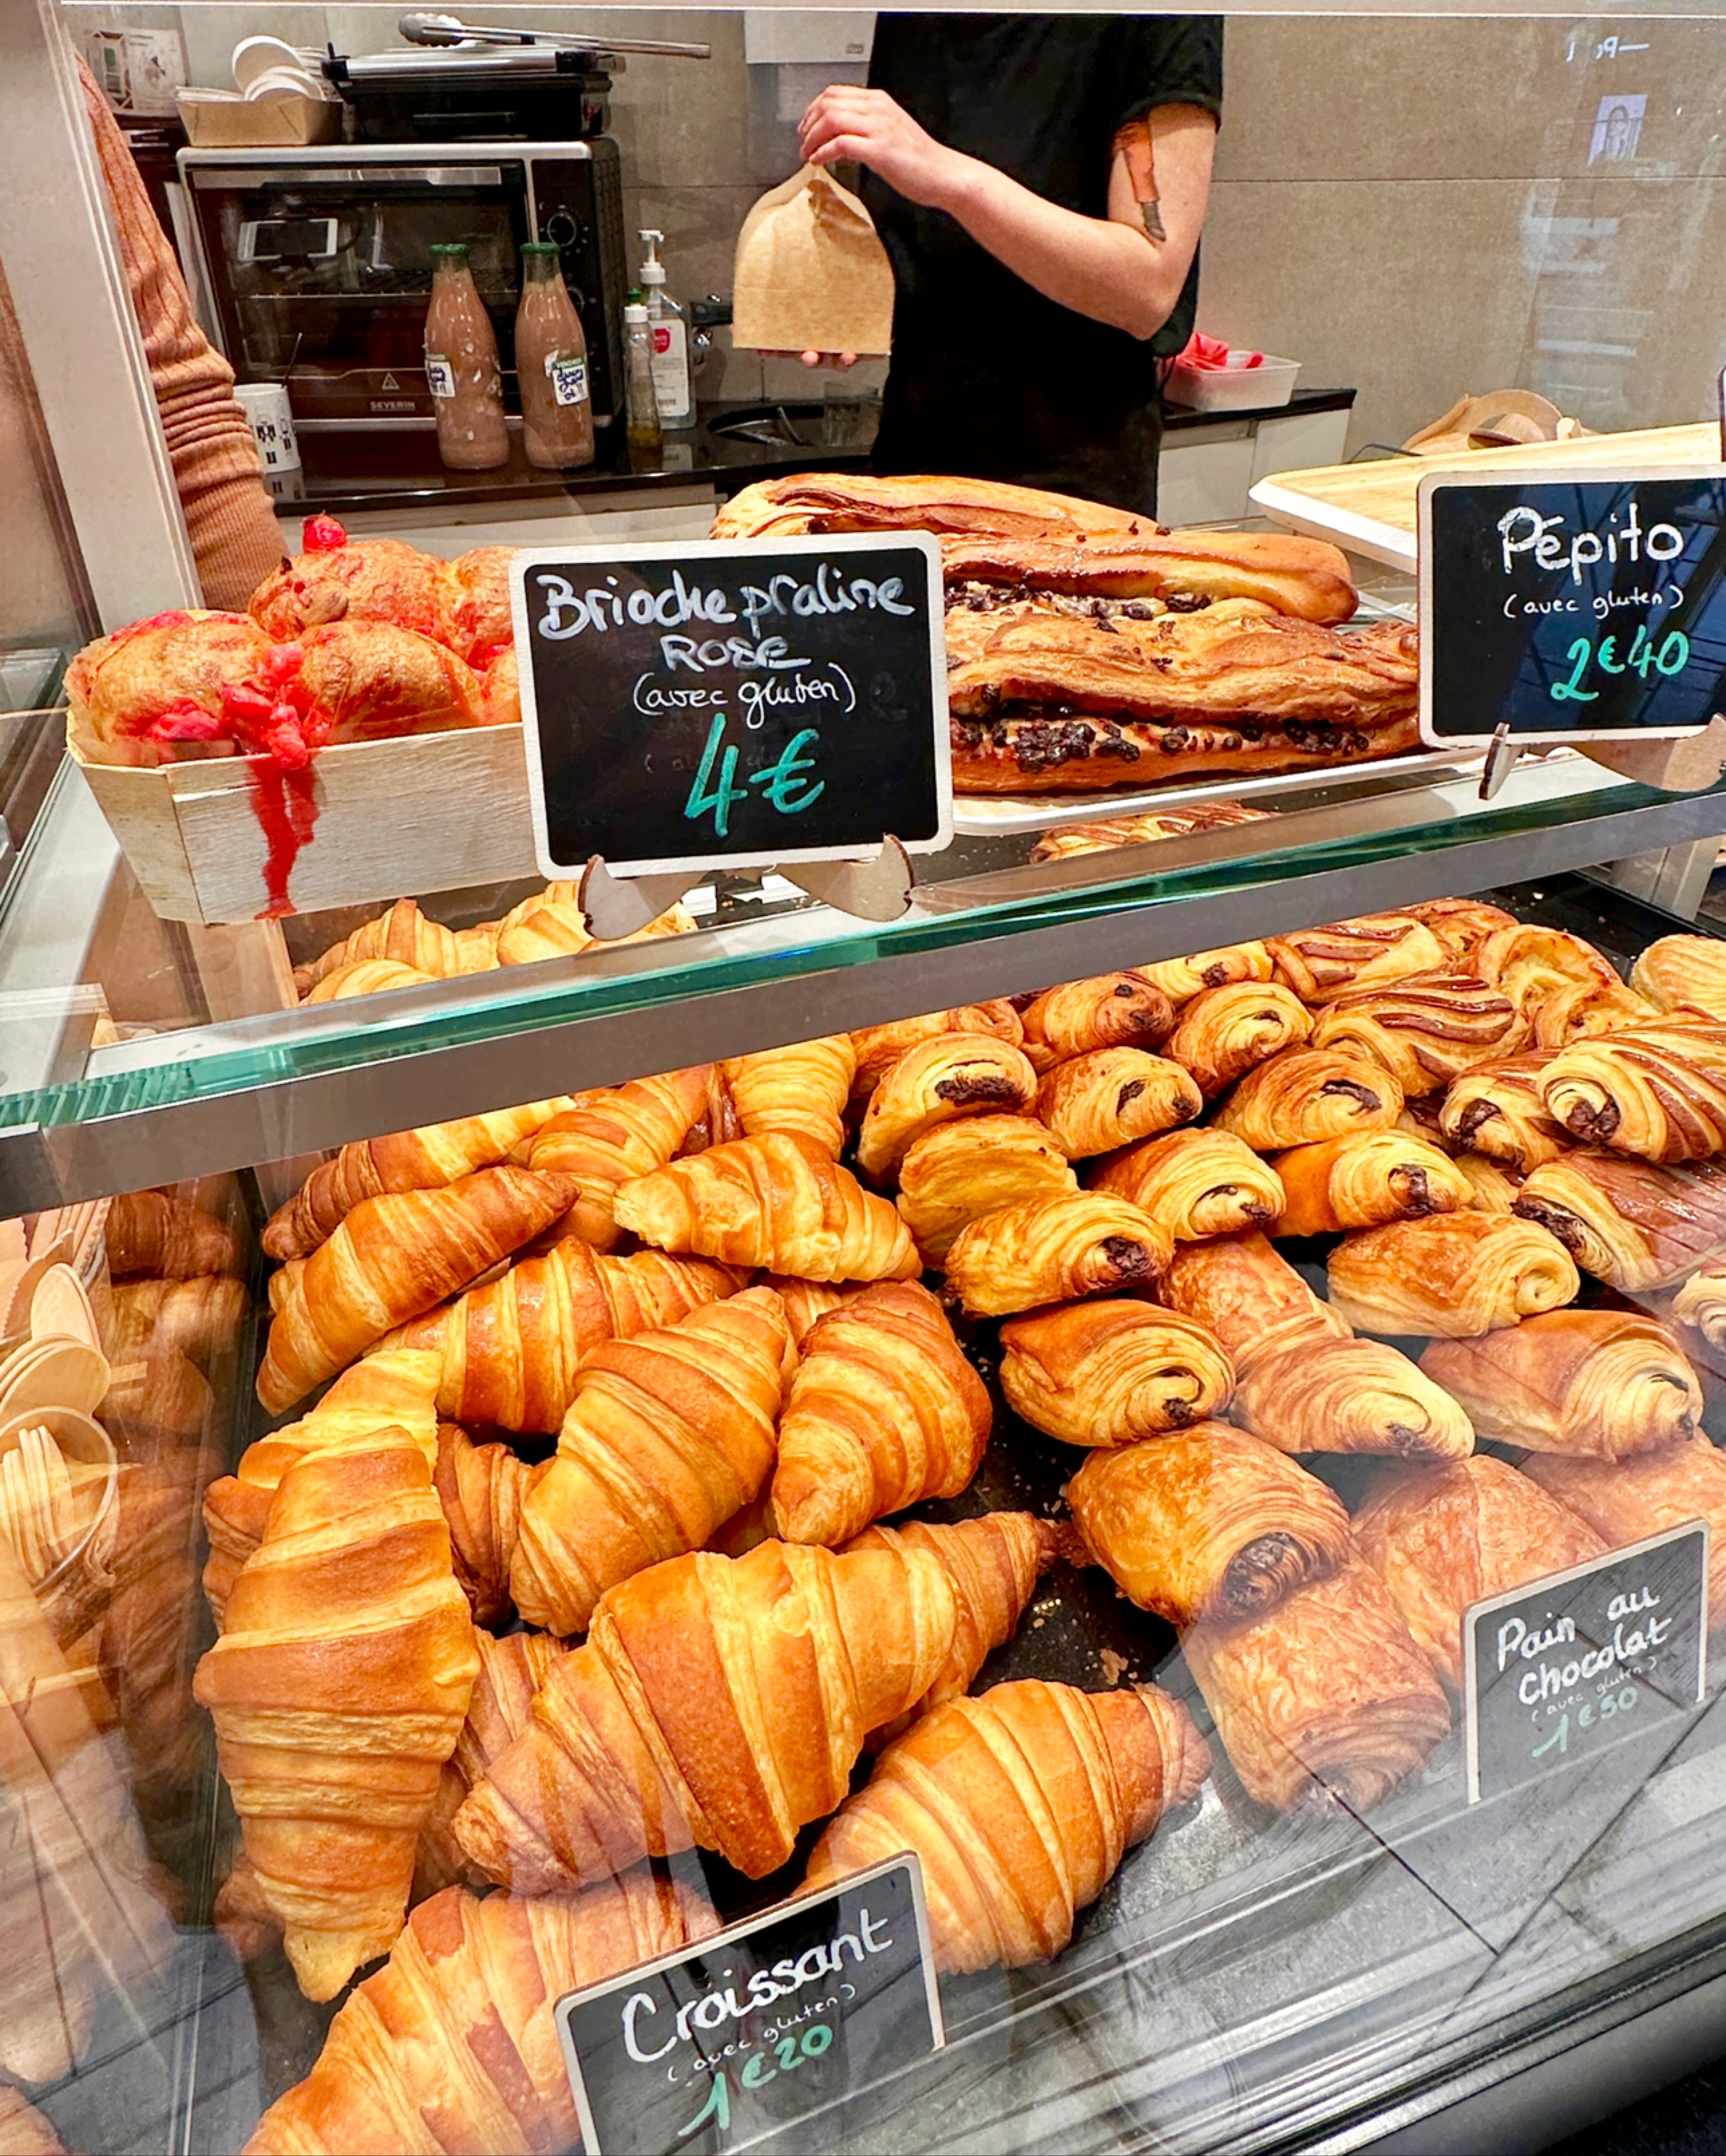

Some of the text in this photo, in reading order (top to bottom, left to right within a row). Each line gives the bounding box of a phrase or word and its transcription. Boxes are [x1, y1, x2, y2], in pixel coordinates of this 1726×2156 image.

[370, 401, 415, 410] SEVERIN
[536, 563, 915, 639] Brioche praline
[1503, 593, 1579, 618] (avec
[633, 662, 858, 729] (avec gluten)
[1550, 625, 1689, 702] 2€40
[1496, 1586, 1660, 1672] Pain au
[1531, 1686, 1638, 1758] 1€50
[622, 1908, 893, 2063] Croissant
[677, 2024, 834, 2138] 1€20
